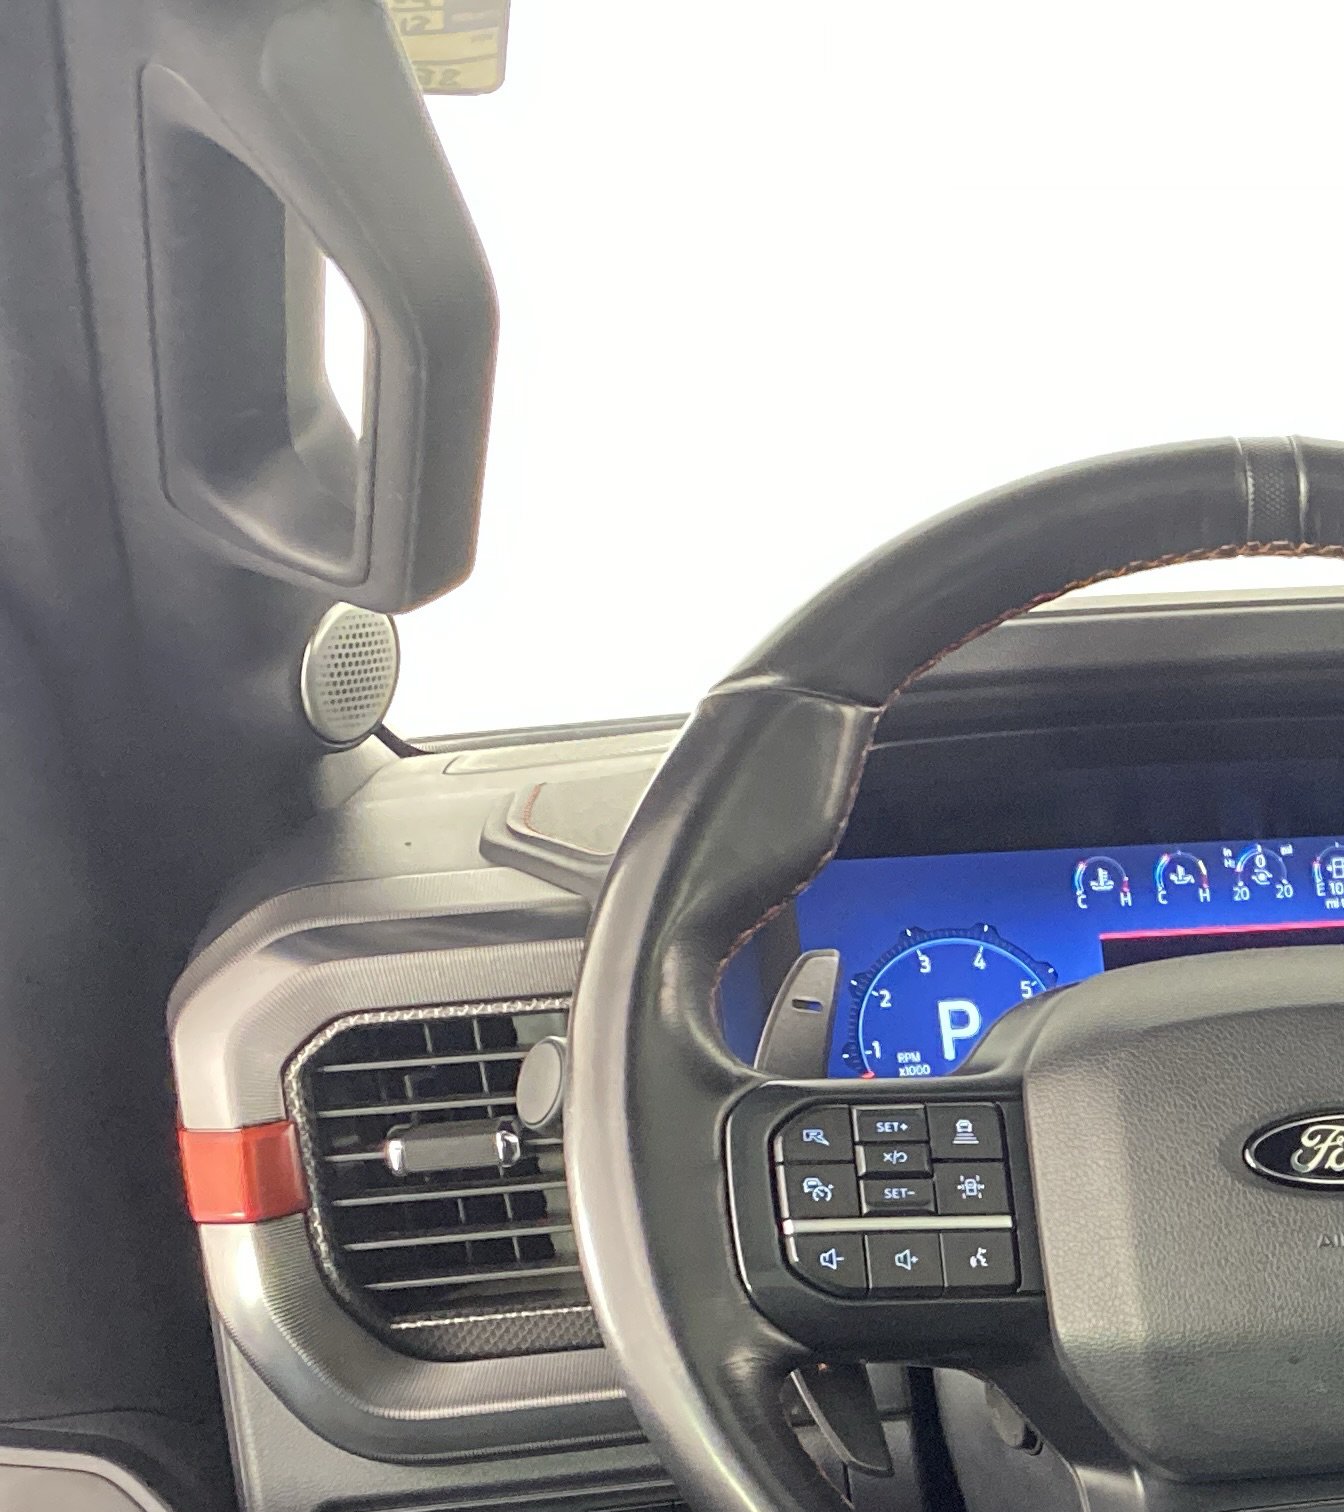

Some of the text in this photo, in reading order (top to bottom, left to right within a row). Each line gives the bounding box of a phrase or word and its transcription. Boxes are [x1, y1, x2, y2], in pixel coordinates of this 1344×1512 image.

[1157, 889, 1168, 905] C
[1199, 888, 1211, 903] H
[1233, 886, 1250, 901] 20
[1276, 884, 1294, 899] 20
[1316, 882, 1326, 897] E
[1077, 895, 1088, 909] C
[1120, 892, 1132, 907] H
[919, 955, 931, 973] 3
[973, 953, 986, 970] 4
[1020, 981, 1033, 999] 5
[879, 990, 892, 1008] 2
[938, 999, 982, 1061] P
[872, 1041, 881, 1059] 1
[897, 1052, 921, 1064] RPM
[899, 1064, 930, 1078] x1000
